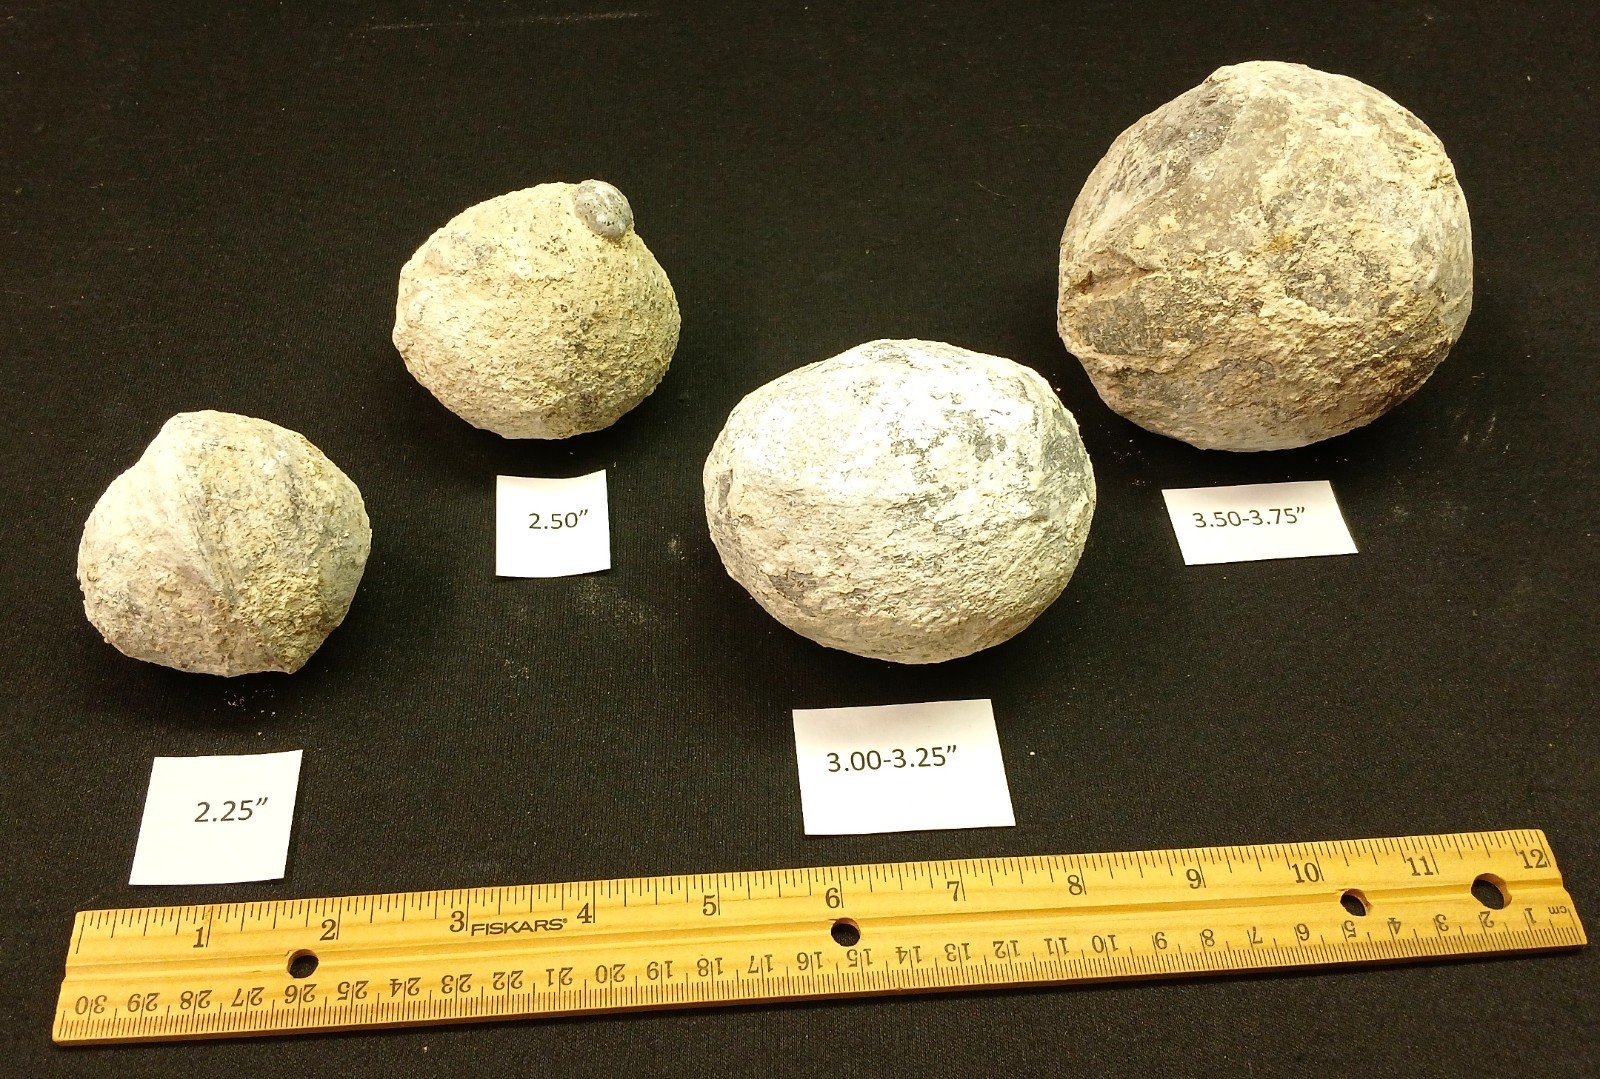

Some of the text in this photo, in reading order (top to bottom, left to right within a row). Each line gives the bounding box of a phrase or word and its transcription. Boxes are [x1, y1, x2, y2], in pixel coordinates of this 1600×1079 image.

[528, 508, 588, 529] 2.50”
[1192, 506, 1305, 528] 3.50-3.75”
[826, 745, 957, 772] 3.00-3.25”
[194, 797, 269, 822] 2.25”
[193, 848, 1548, 948] 1 2 3 4 5 6 7 8 9 10 11 12
[75, 905, 1568, 1015] cm 1 2 3 4 5 6 7 8 9 10 11 12 13 14 15 16 17 18 19 20 21 22 23 24 25 26 27 28 29 30
